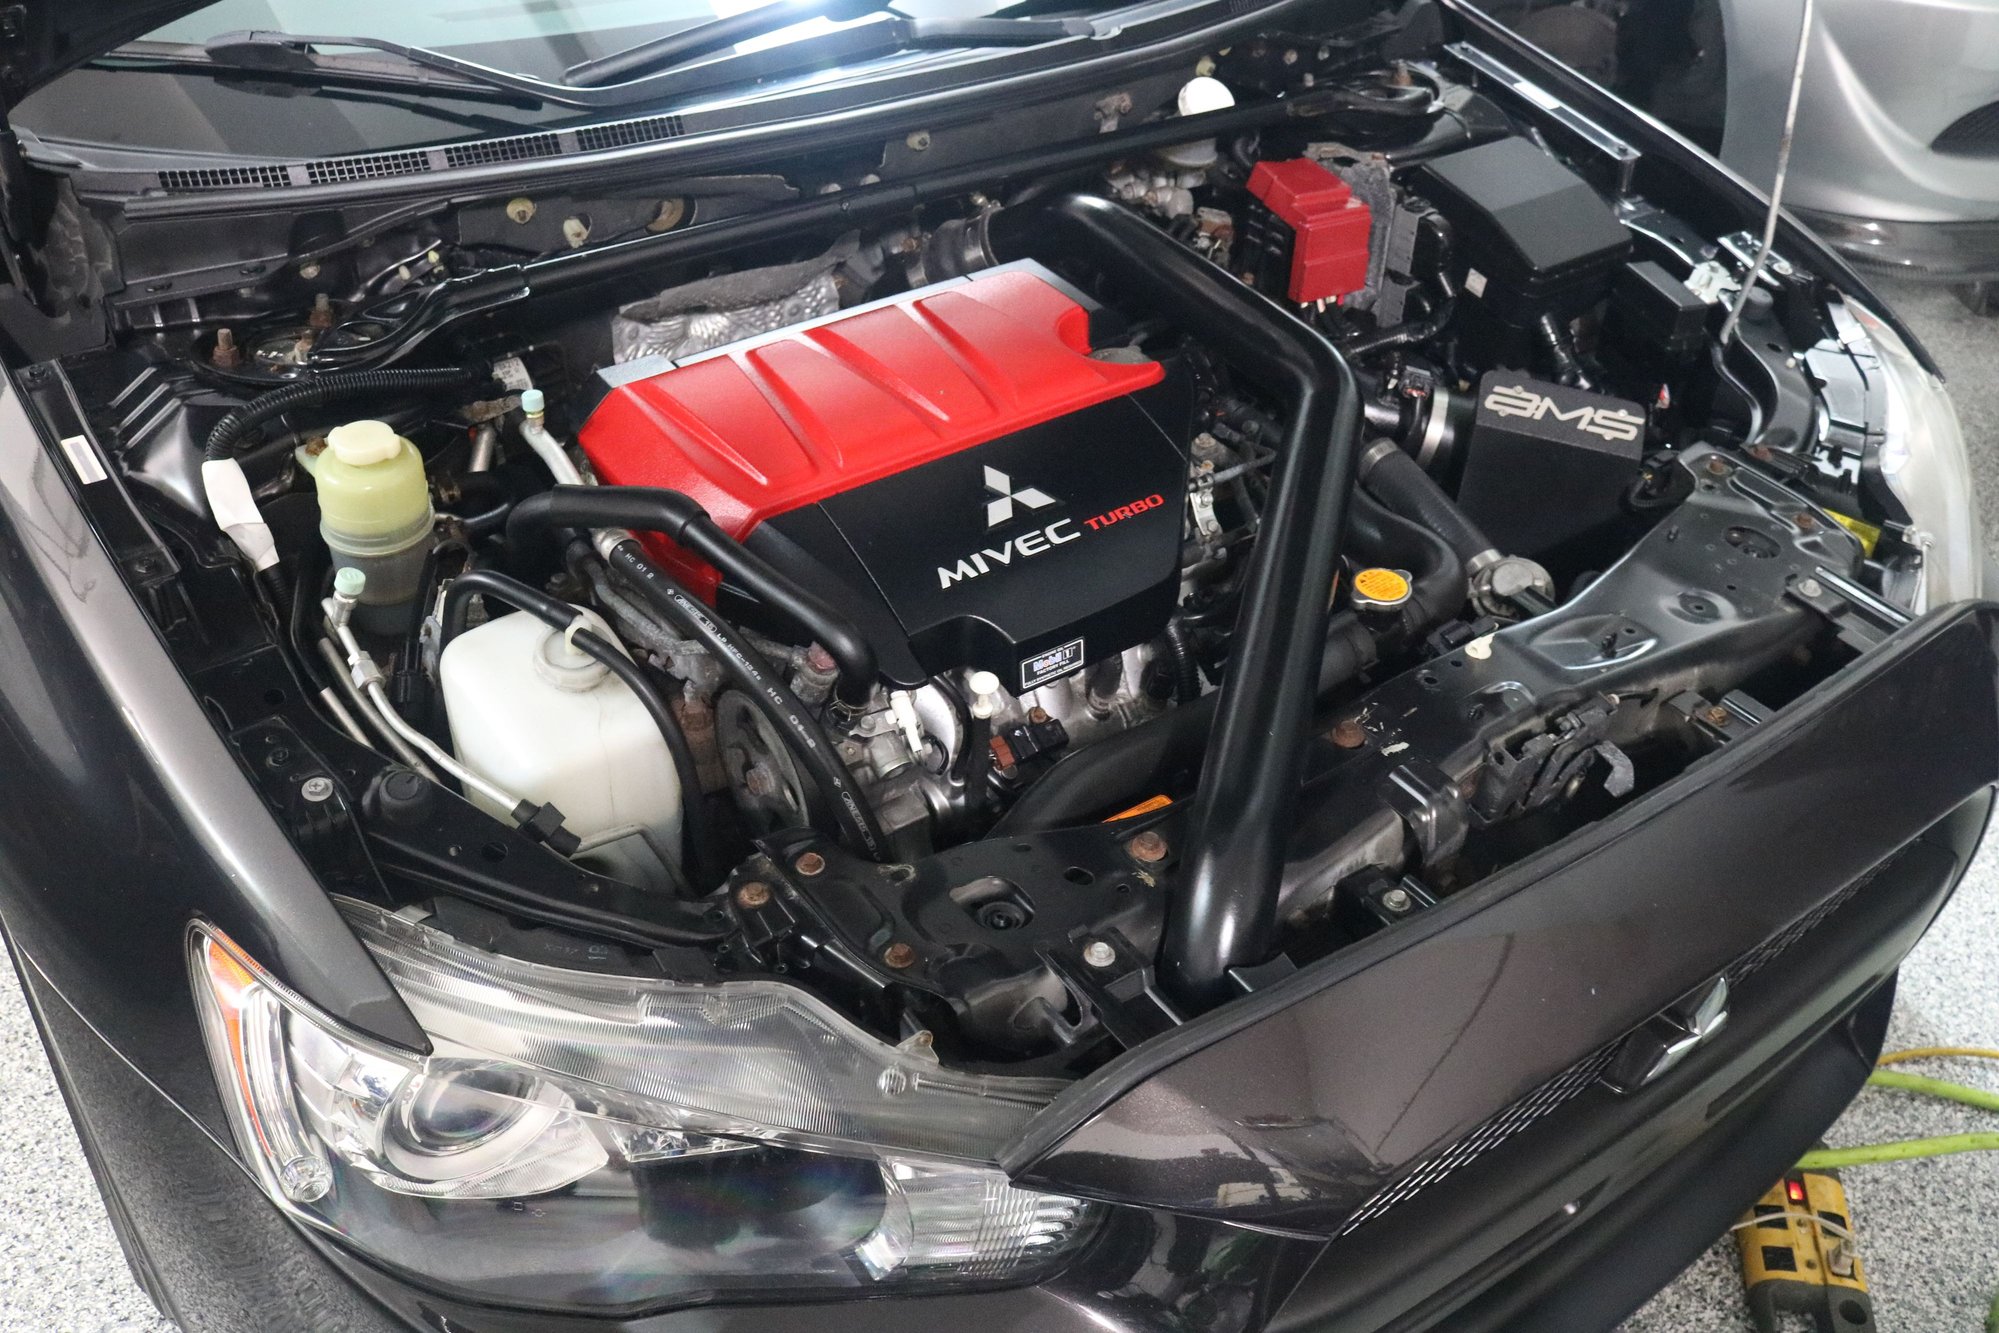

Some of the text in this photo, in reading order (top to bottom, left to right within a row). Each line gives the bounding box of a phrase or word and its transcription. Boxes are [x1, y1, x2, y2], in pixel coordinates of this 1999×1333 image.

[937, 493, 1165, 590] MIVEC TURBO
[1033, 652, 1062, 672] Mobil
[1036, 664, 1058, 675] FACTORY
